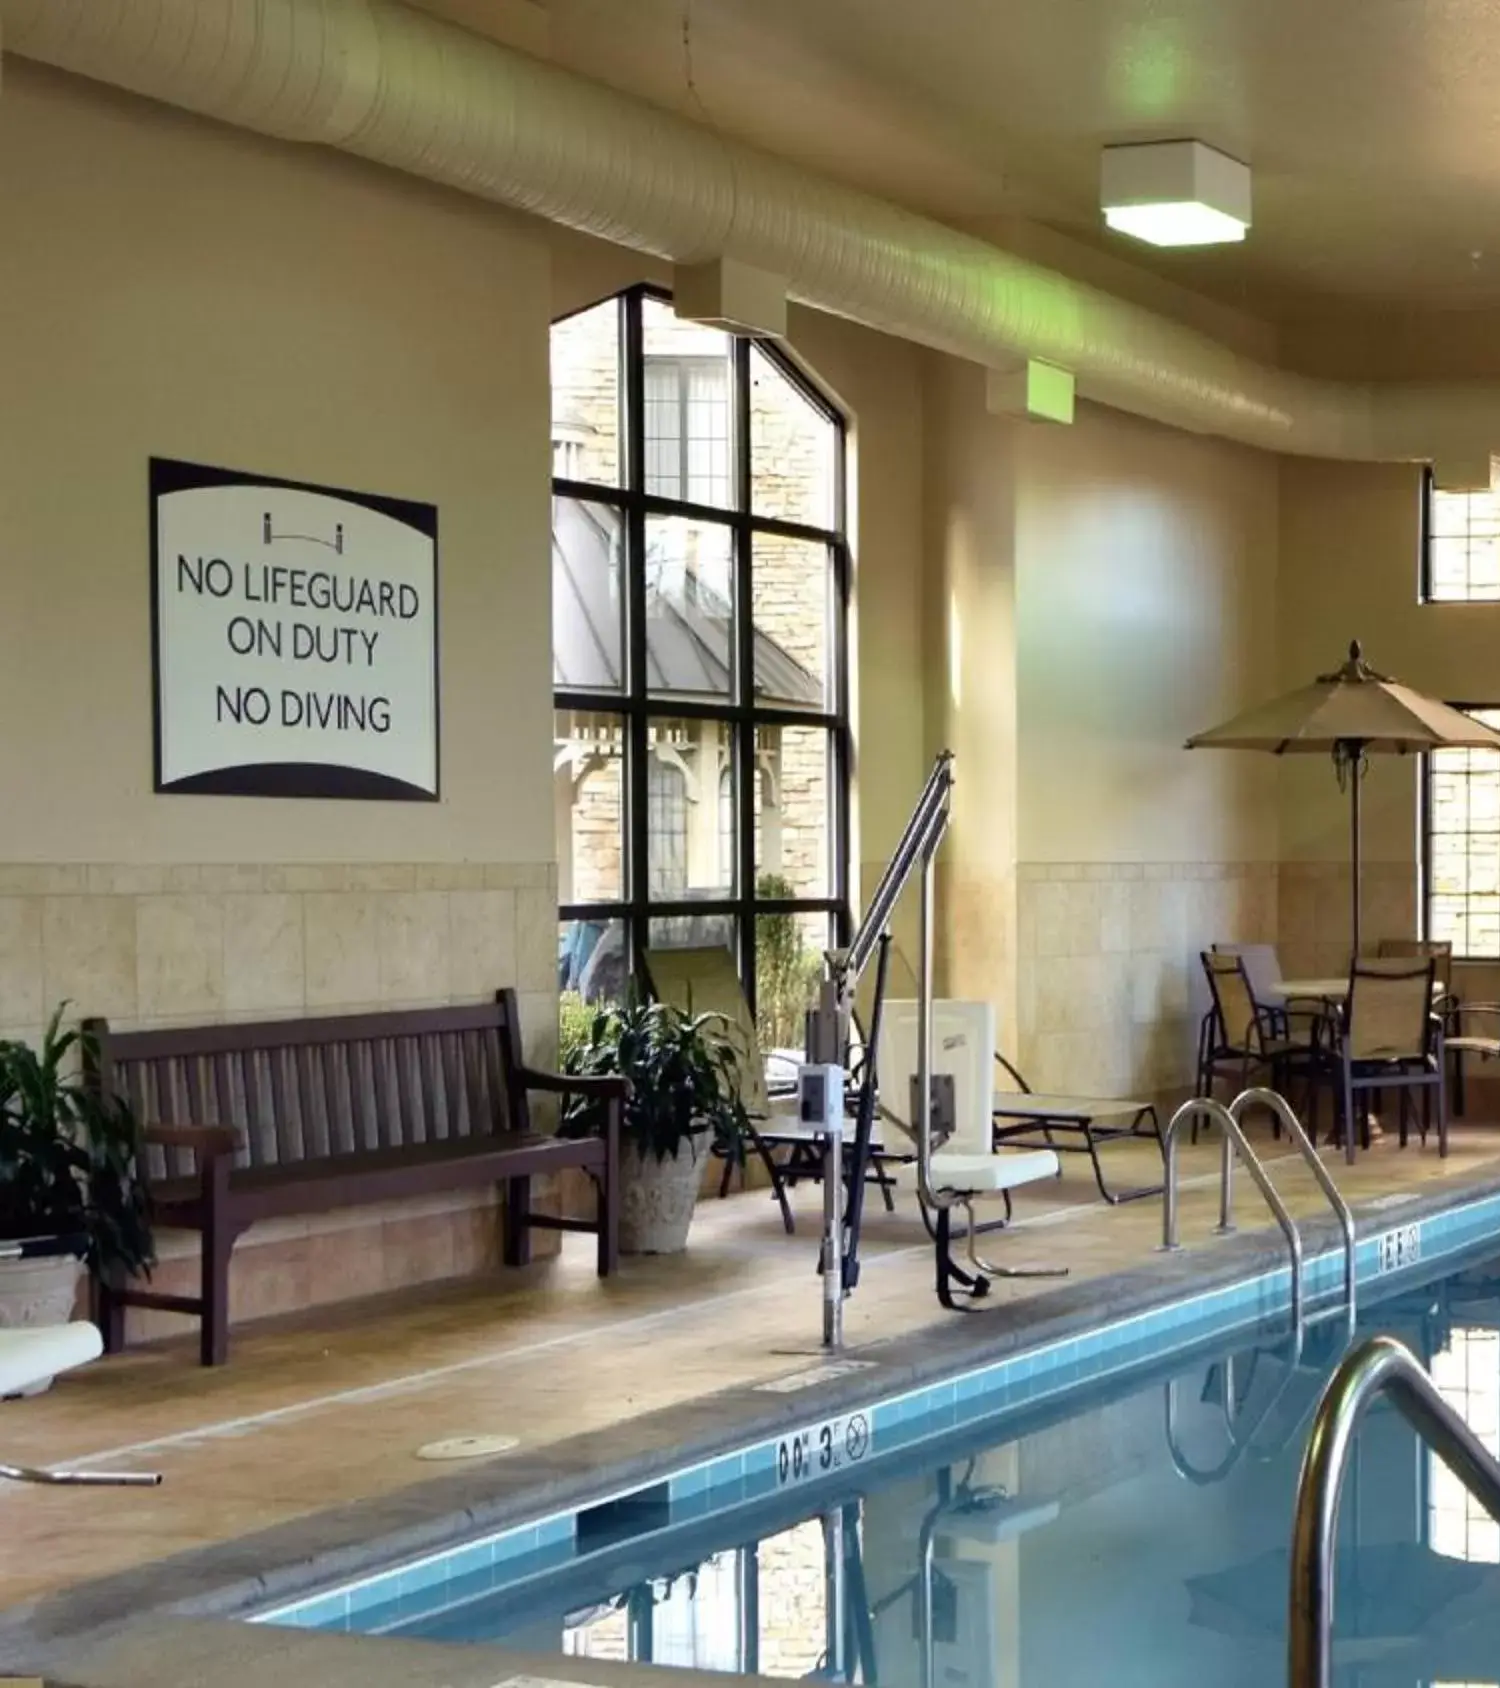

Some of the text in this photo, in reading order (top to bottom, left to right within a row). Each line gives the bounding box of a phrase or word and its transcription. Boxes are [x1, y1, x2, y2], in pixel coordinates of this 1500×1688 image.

[177, 554, 420, 620] NO LIFEGUARD
[227, 616, 379, 667] ON DUTY
[215, 684, 391, 733] NO DIVING
